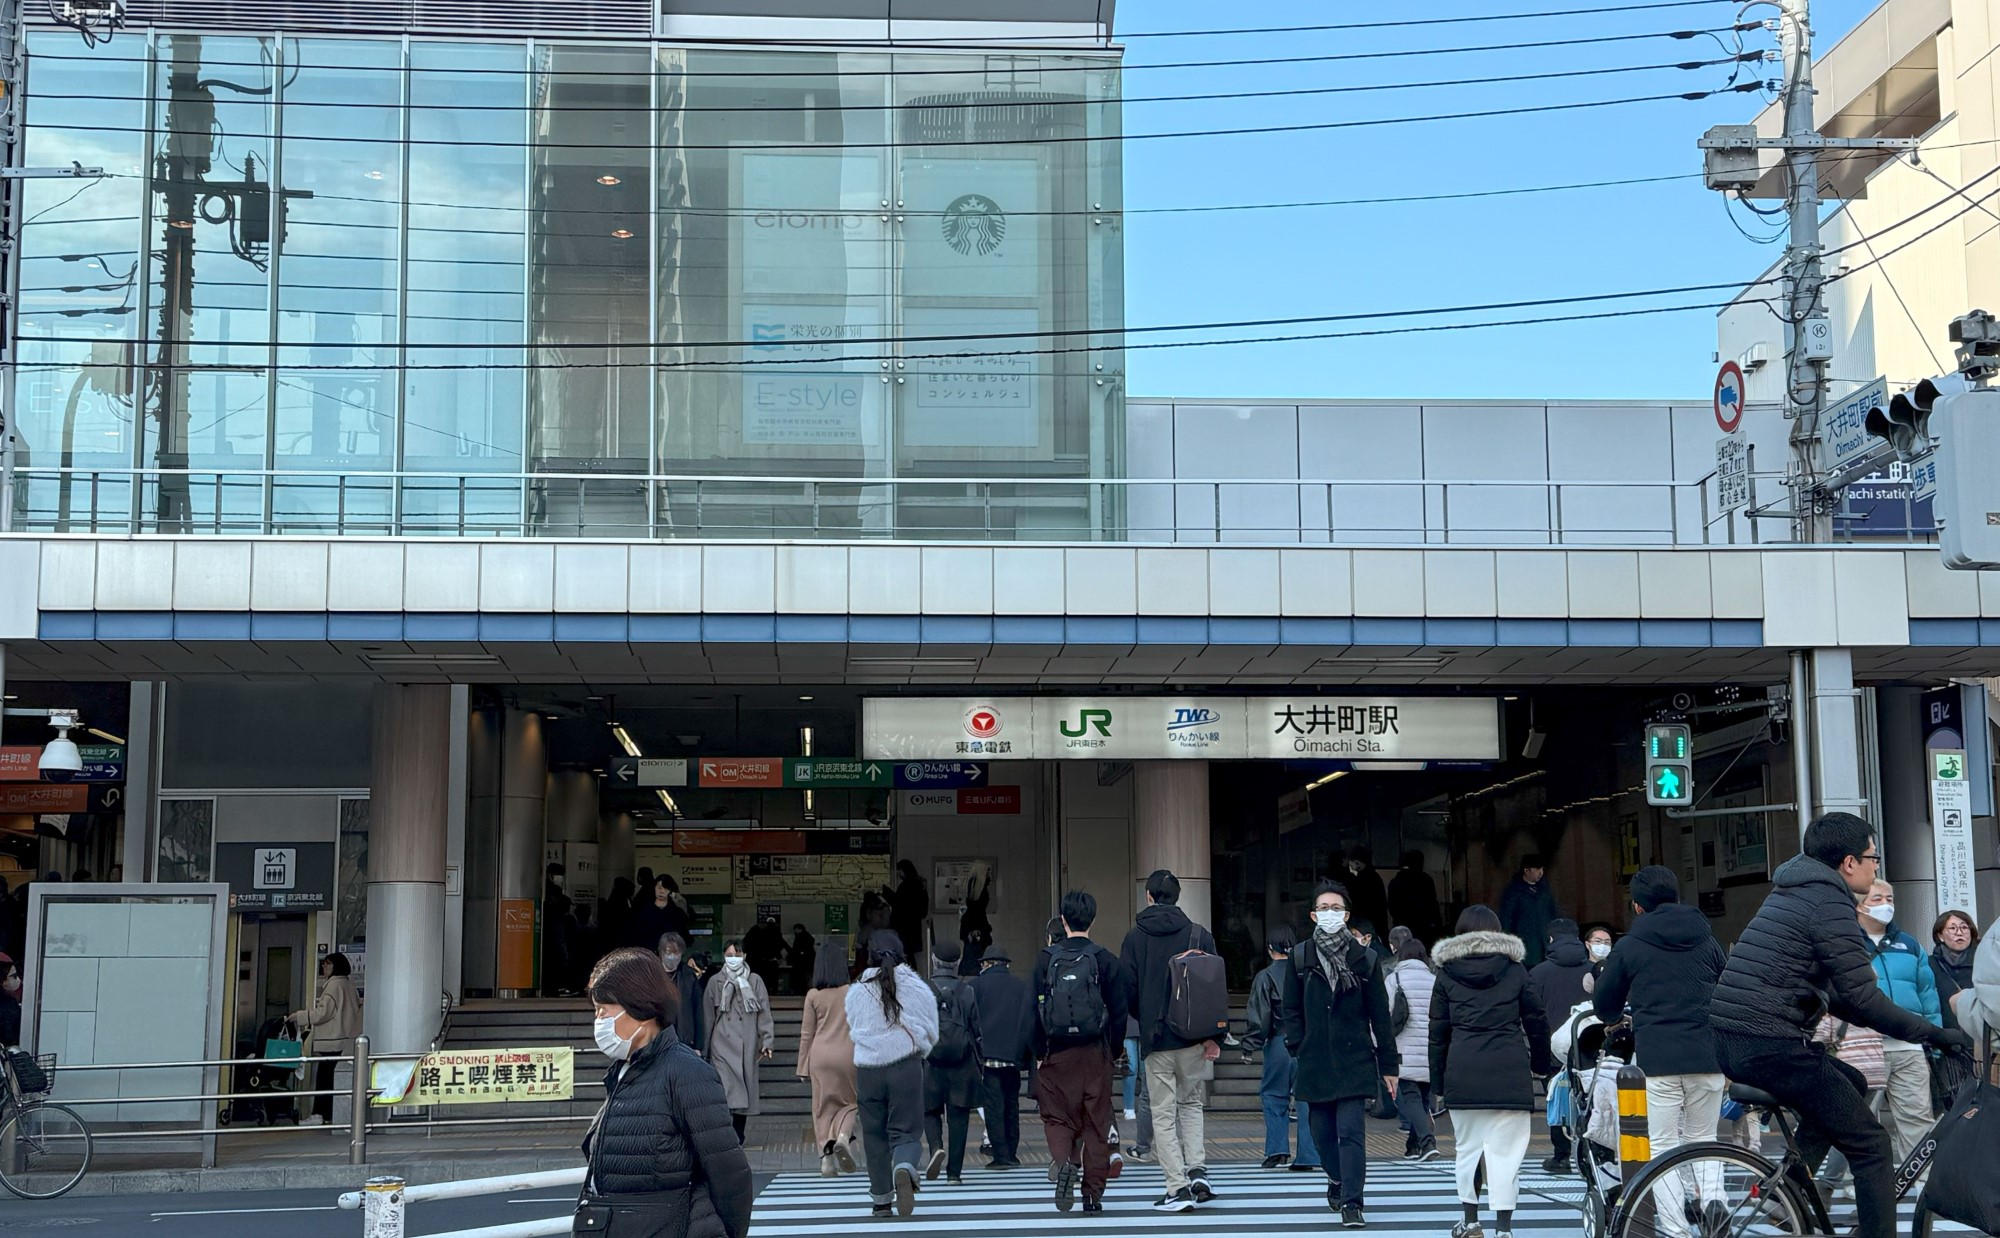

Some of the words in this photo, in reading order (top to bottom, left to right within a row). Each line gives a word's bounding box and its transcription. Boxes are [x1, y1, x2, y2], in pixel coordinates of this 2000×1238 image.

[757, 382, 857, 411] E-style
[928, 389, 1021, 399] コンシェルジュ
[1174, 708, 1210, 724] TWR
[1273, 704, 1400, 735] 大井町駅
[1059, 709, 1113, 738] JR
[1168, 731, 1221, 743] りんかい線
[955, 741, 1013, 754] 東急電鉄
[1066, 739, 1107, 748] JR東日本
[1356, 738, 1385, 753] Sta.
[722, 768, 737, 777] OM
[739, 763, 770, 774] 大井町線
[798, 765, 810, 777] JK
[9, 794, 28, 803] OM
[29, 788, 73, 799] 大井町線
[925, 796, 953, 805] MUFG
[420, 1056, 436, 1067] NO
[439, 1055, 490, 1066] SMOKING
[535, 1052, 554, 1063] 금연
[419, 1063, 561, 1088] 路上喫煙禁止
